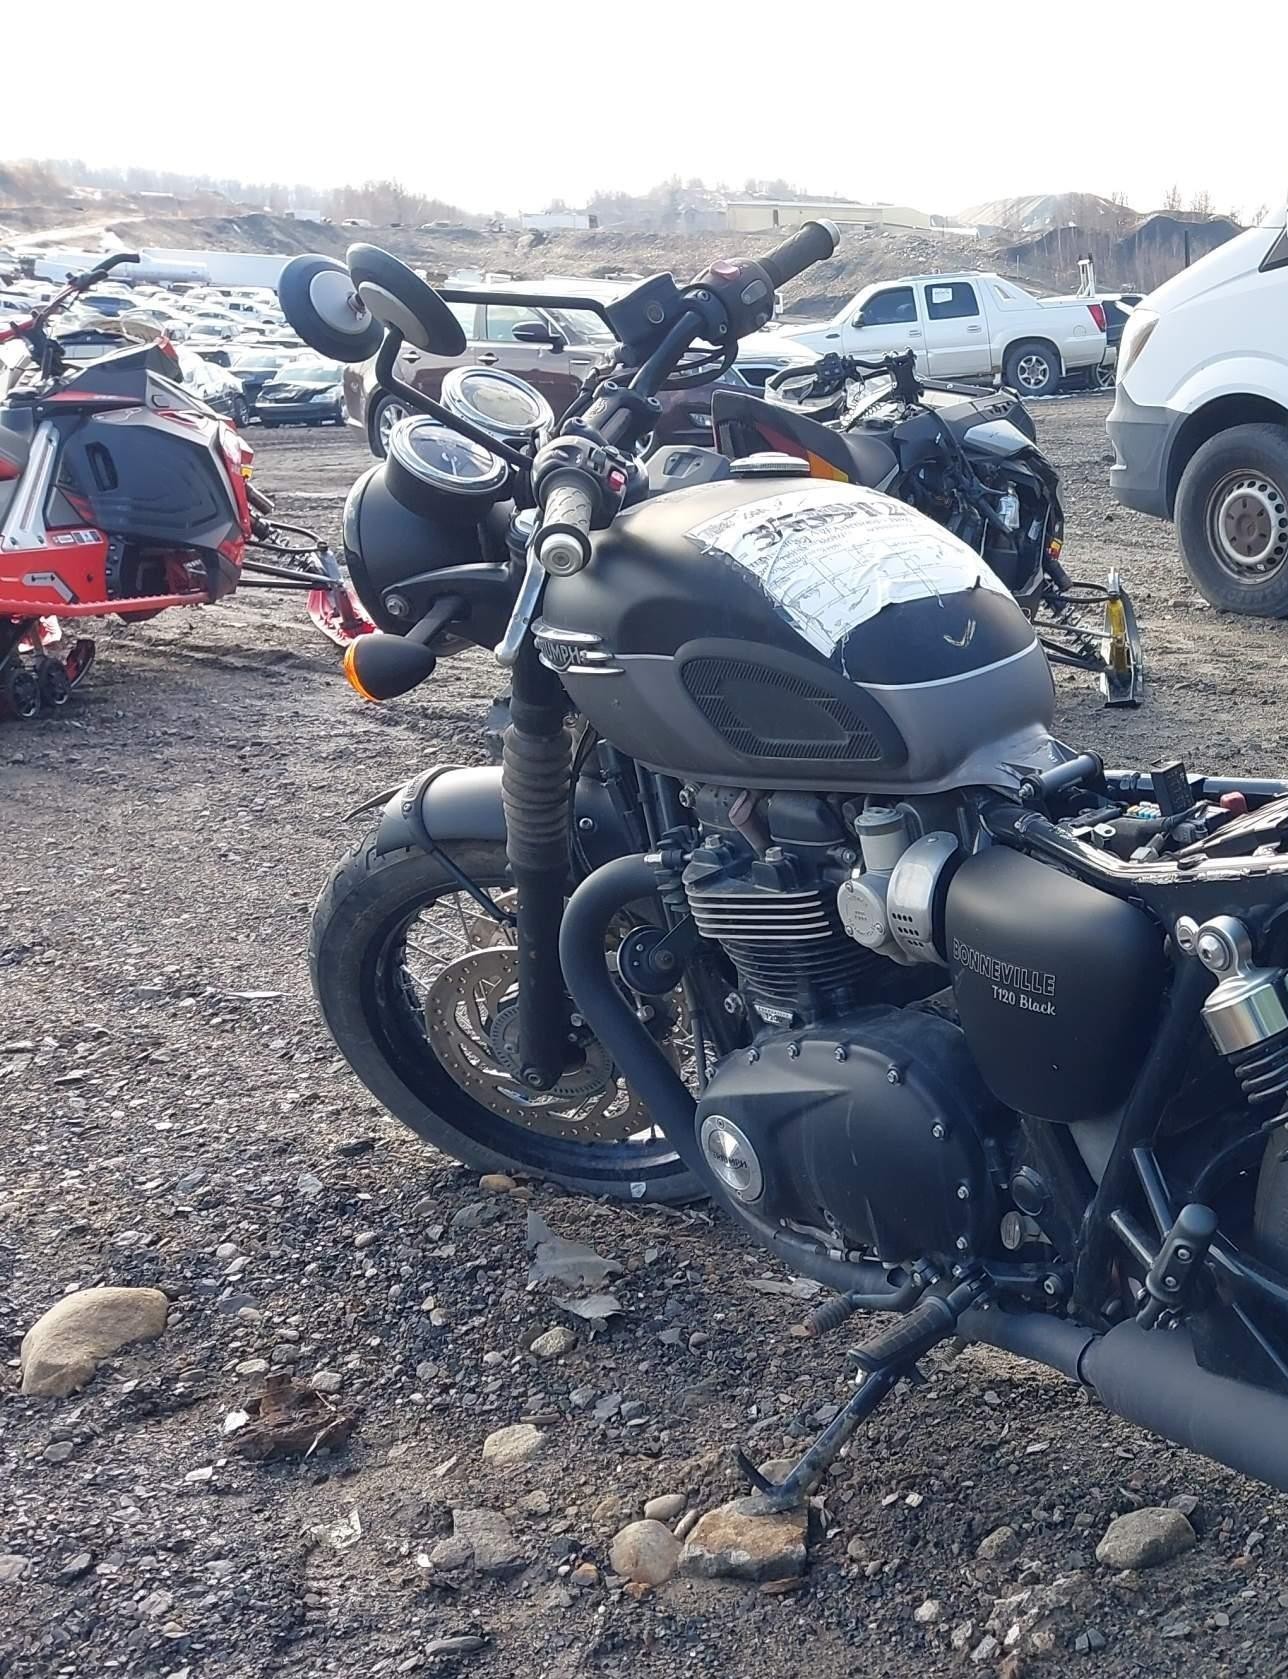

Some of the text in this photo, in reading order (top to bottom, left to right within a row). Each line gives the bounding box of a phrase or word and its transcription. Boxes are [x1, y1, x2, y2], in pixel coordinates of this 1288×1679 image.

[952, 937, 1056, 996] BONNEVILLE
[991, 984, 1056, 1016] T120 Black
